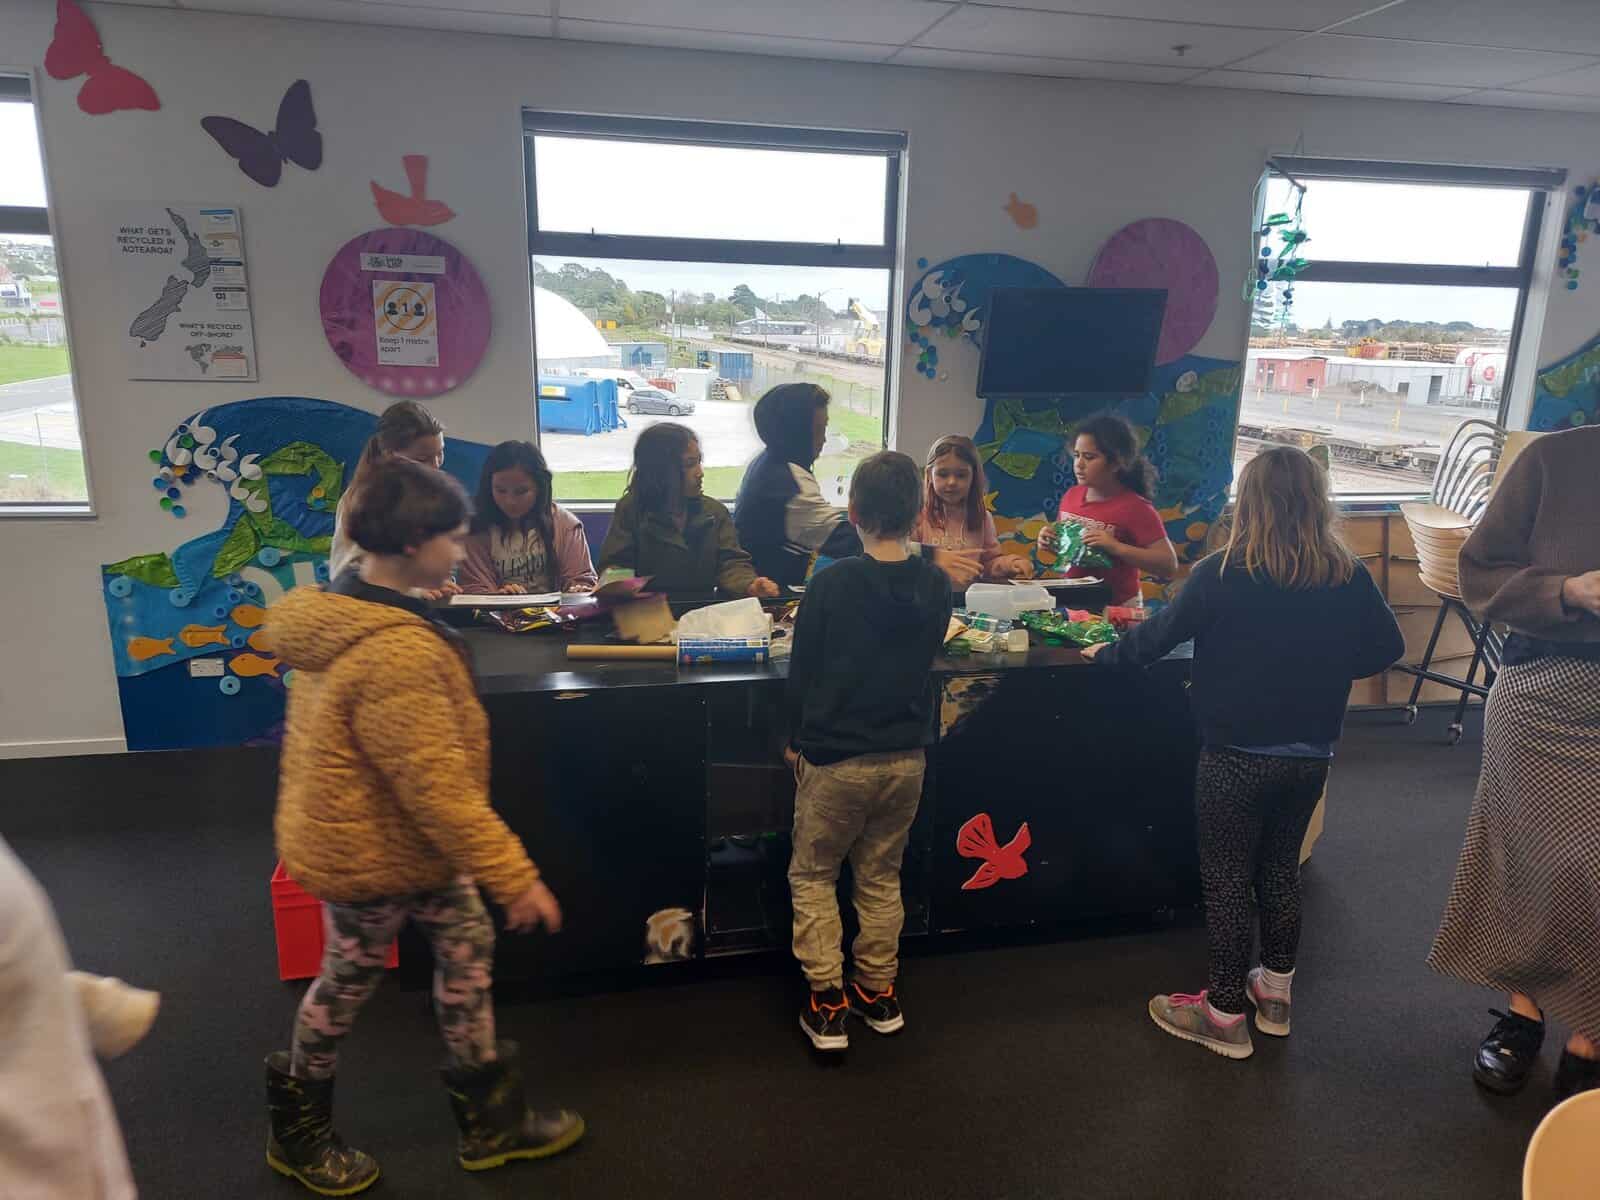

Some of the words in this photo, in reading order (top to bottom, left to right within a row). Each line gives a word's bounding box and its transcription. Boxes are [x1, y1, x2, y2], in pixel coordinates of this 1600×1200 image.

[120, 226, 144, 234] WHAT
[148, 227, 171, 236] GETS
[117, 236, 163, 245] RECYCLED
[402, 303, 408, 313] 1
[379, 336, 399, 345] Keep
